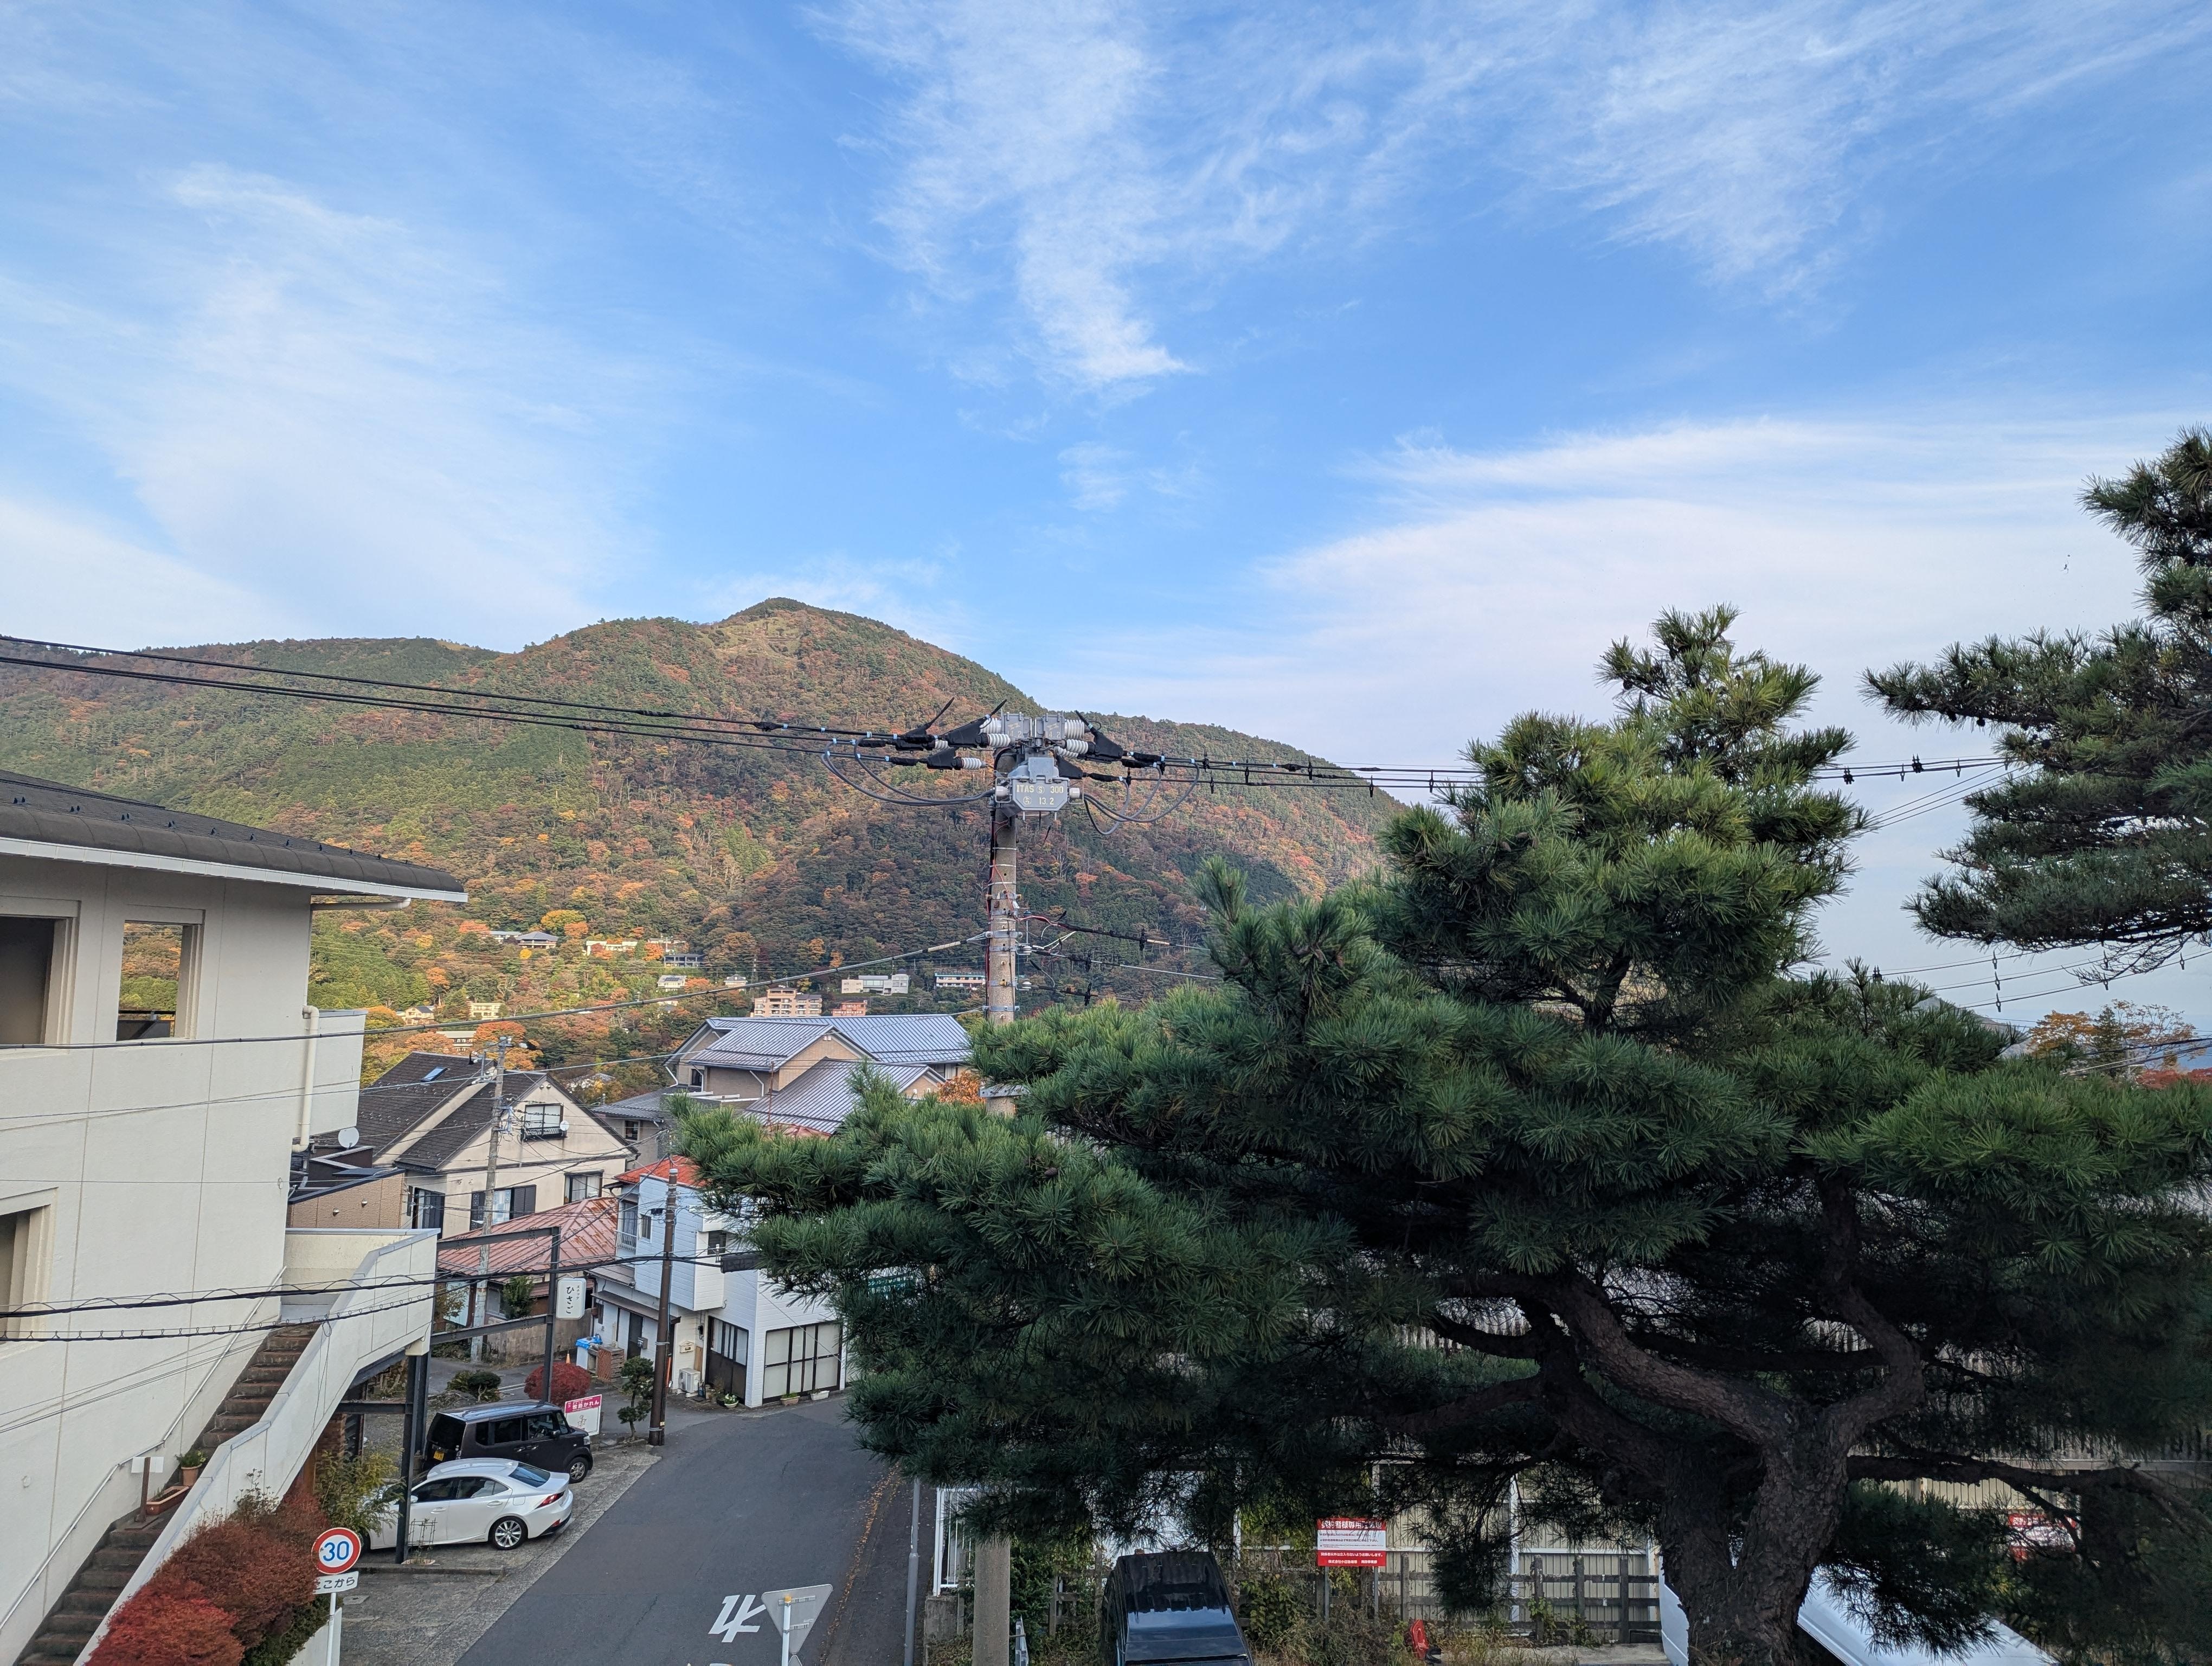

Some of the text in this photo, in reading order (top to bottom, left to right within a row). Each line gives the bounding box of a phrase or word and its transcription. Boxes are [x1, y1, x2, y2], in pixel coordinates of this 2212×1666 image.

[1017, 785, 1034, 793] ITAS
[565, 1286, 575, 1314] ひさご
[323, 1541, 349, 1561] 30
